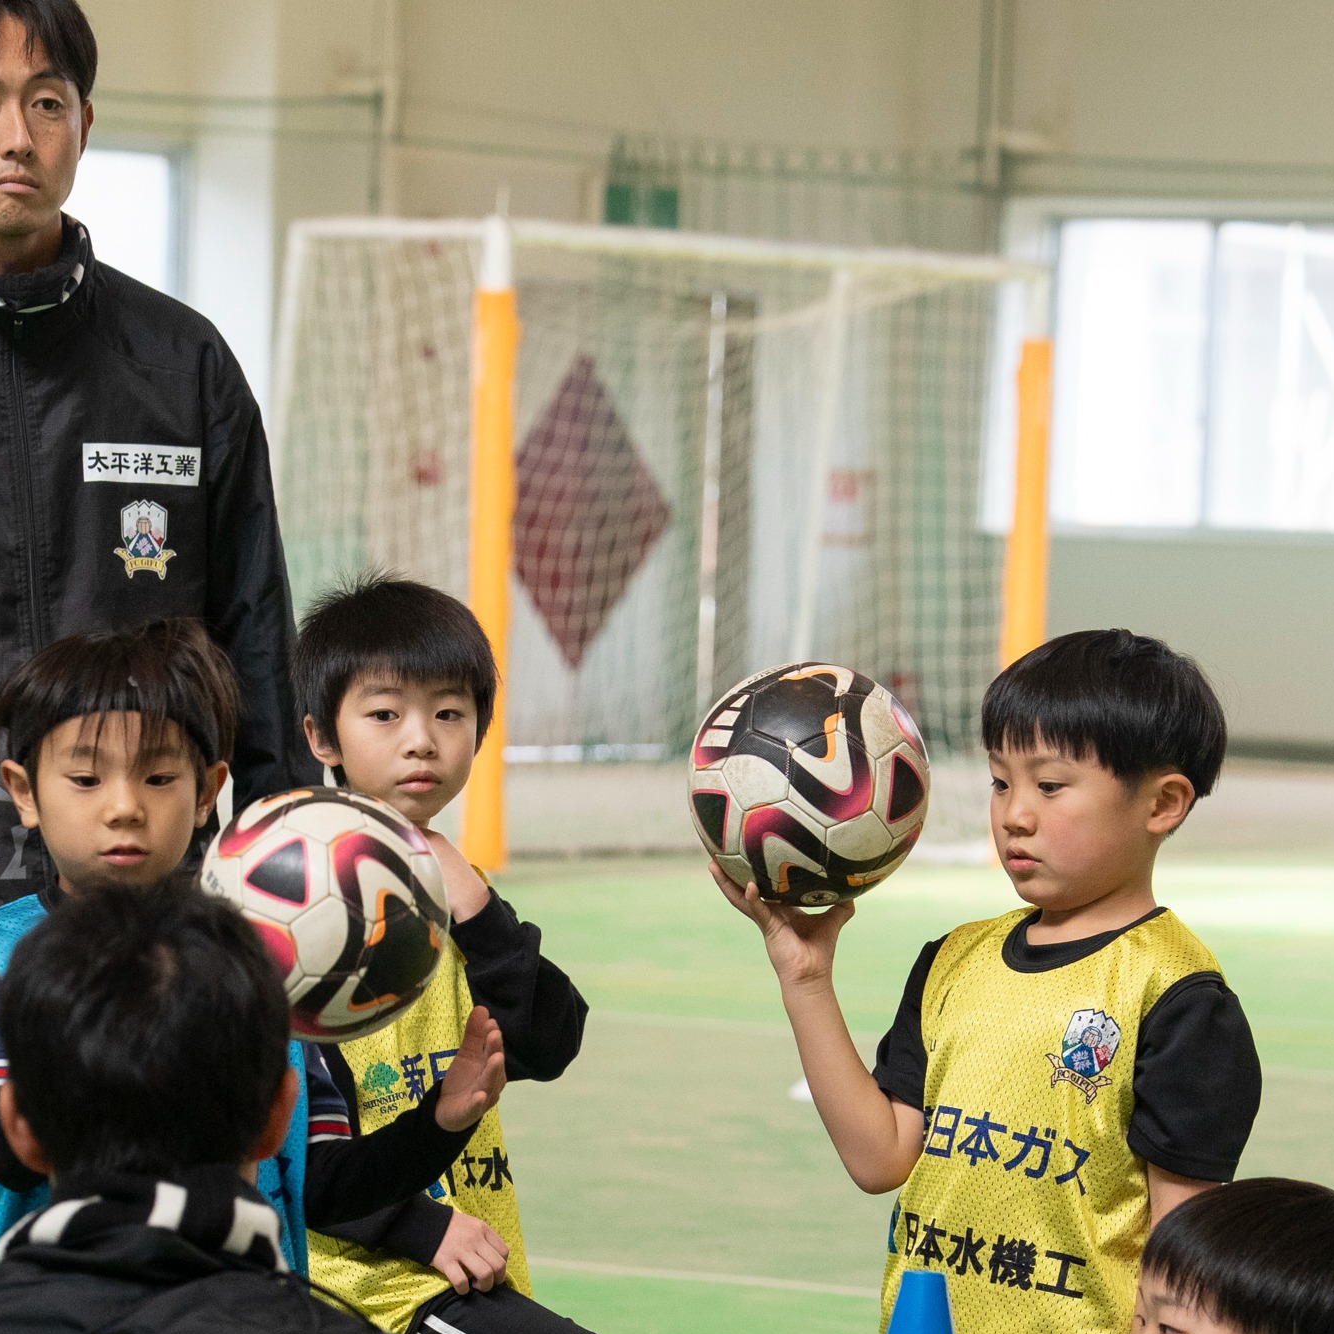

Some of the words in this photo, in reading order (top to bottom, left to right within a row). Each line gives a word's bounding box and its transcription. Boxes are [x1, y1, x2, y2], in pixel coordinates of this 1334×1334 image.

[87, 451, 197, 477] 太平洋工業
[379, 1102, 399, 1115] GAS
